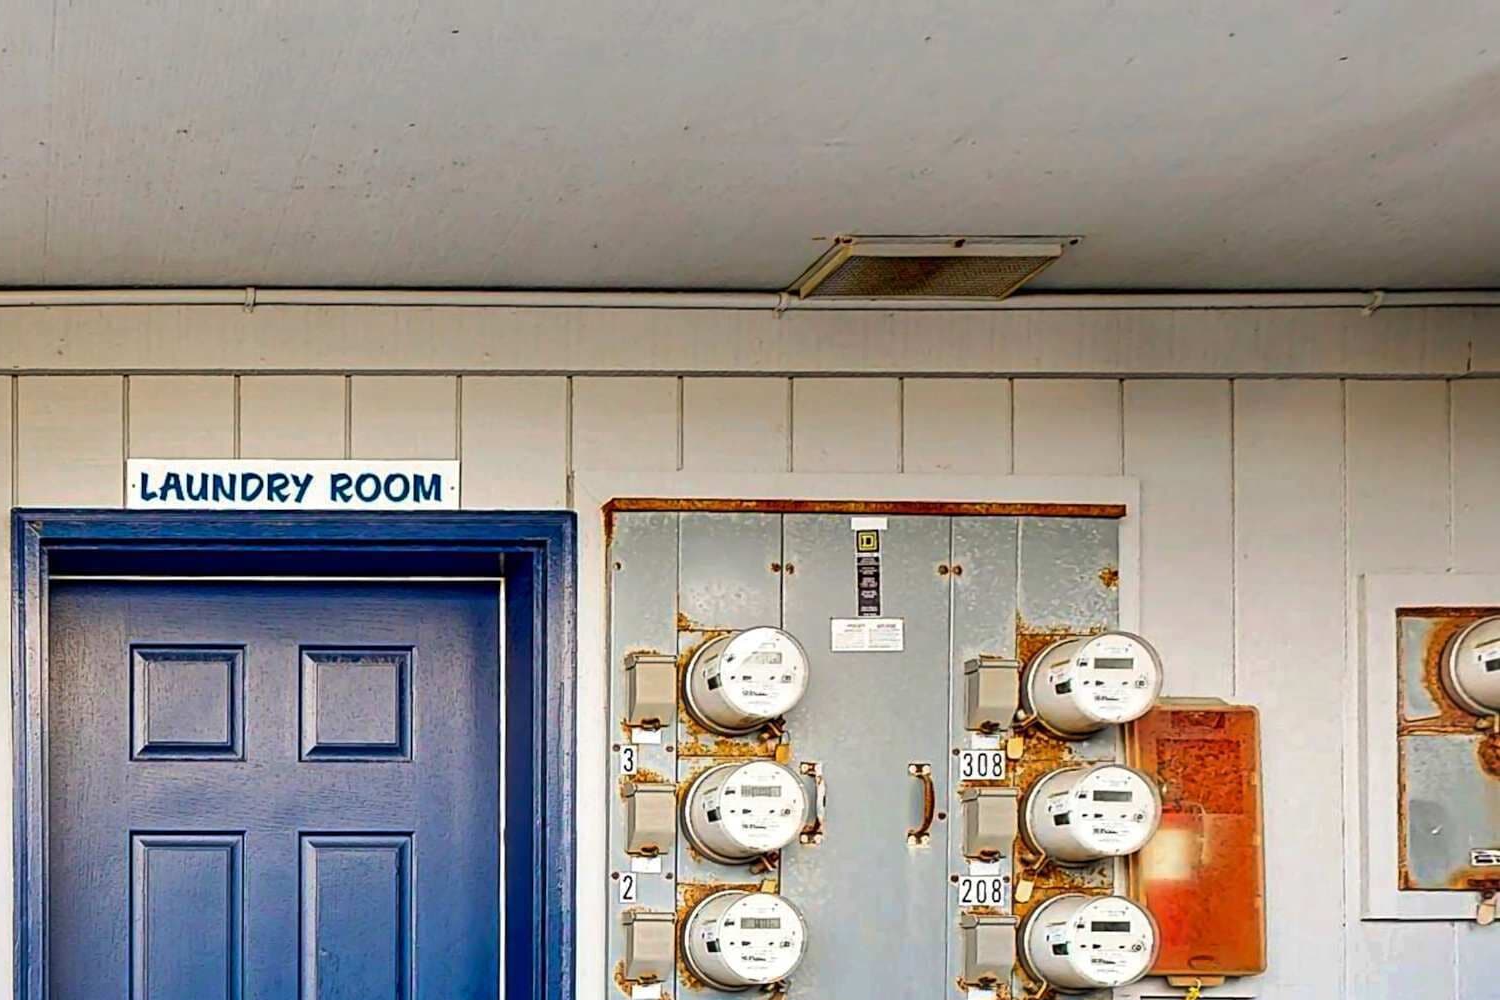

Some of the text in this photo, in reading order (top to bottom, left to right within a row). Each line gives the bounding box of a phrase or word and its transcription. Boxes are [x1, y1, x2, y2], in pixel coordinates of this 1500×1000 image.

[140, 471, 443, 503] LAUNDRY ROOM
[622, 747, 634, 773] 3
[962, 752, 1004, 778] 308
[622, 875, 634, 901] 2
[961, 879, 1003, 904] 208
